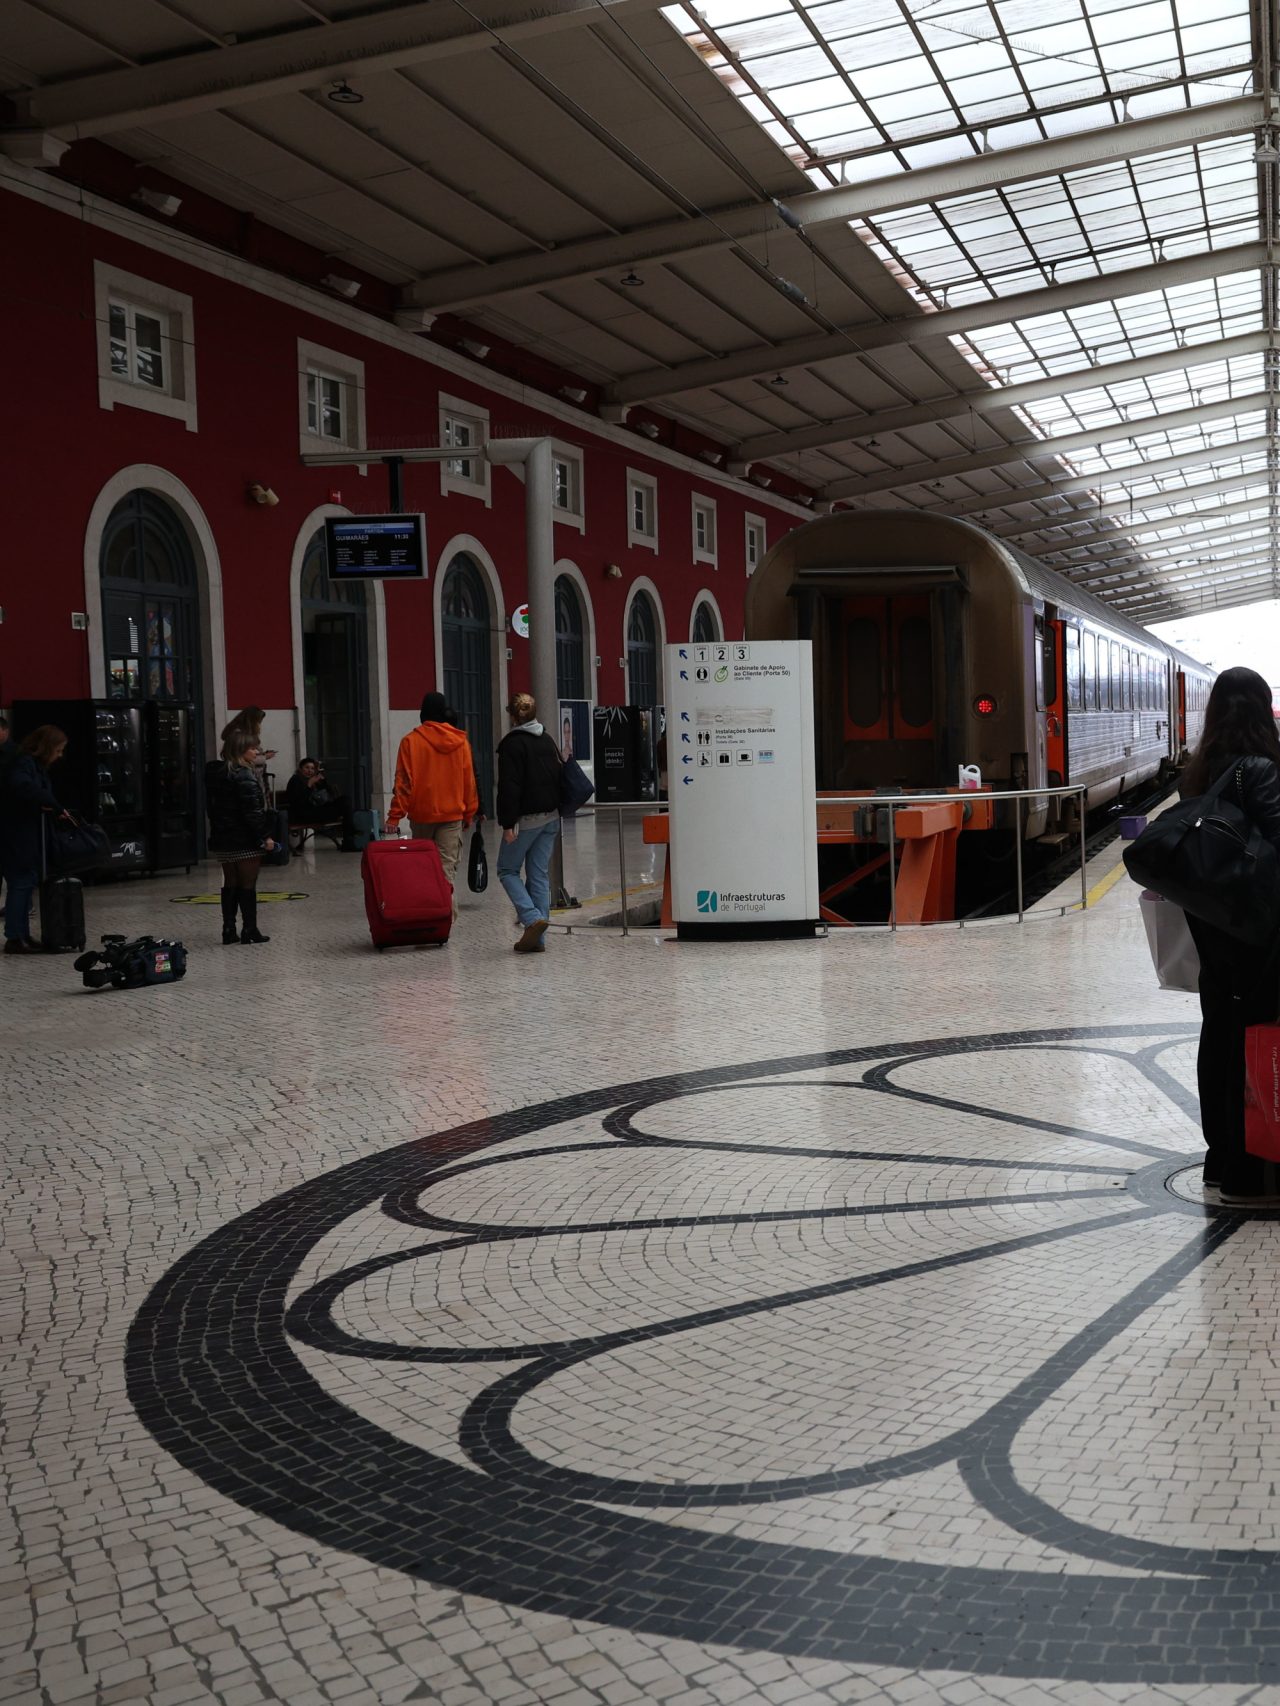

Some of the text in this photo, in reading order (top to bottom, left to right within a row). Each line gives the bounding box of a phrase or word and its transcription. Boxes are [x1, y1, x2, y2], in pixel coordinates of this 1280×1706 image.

[699, 650, 705, 661] 1
[718, 650, 725, 660] 2
[737, 650, 745, 660] 3
[720, 893, 786, 901] Infraestruturas
[720, 903, 766, 912] de Portugal
